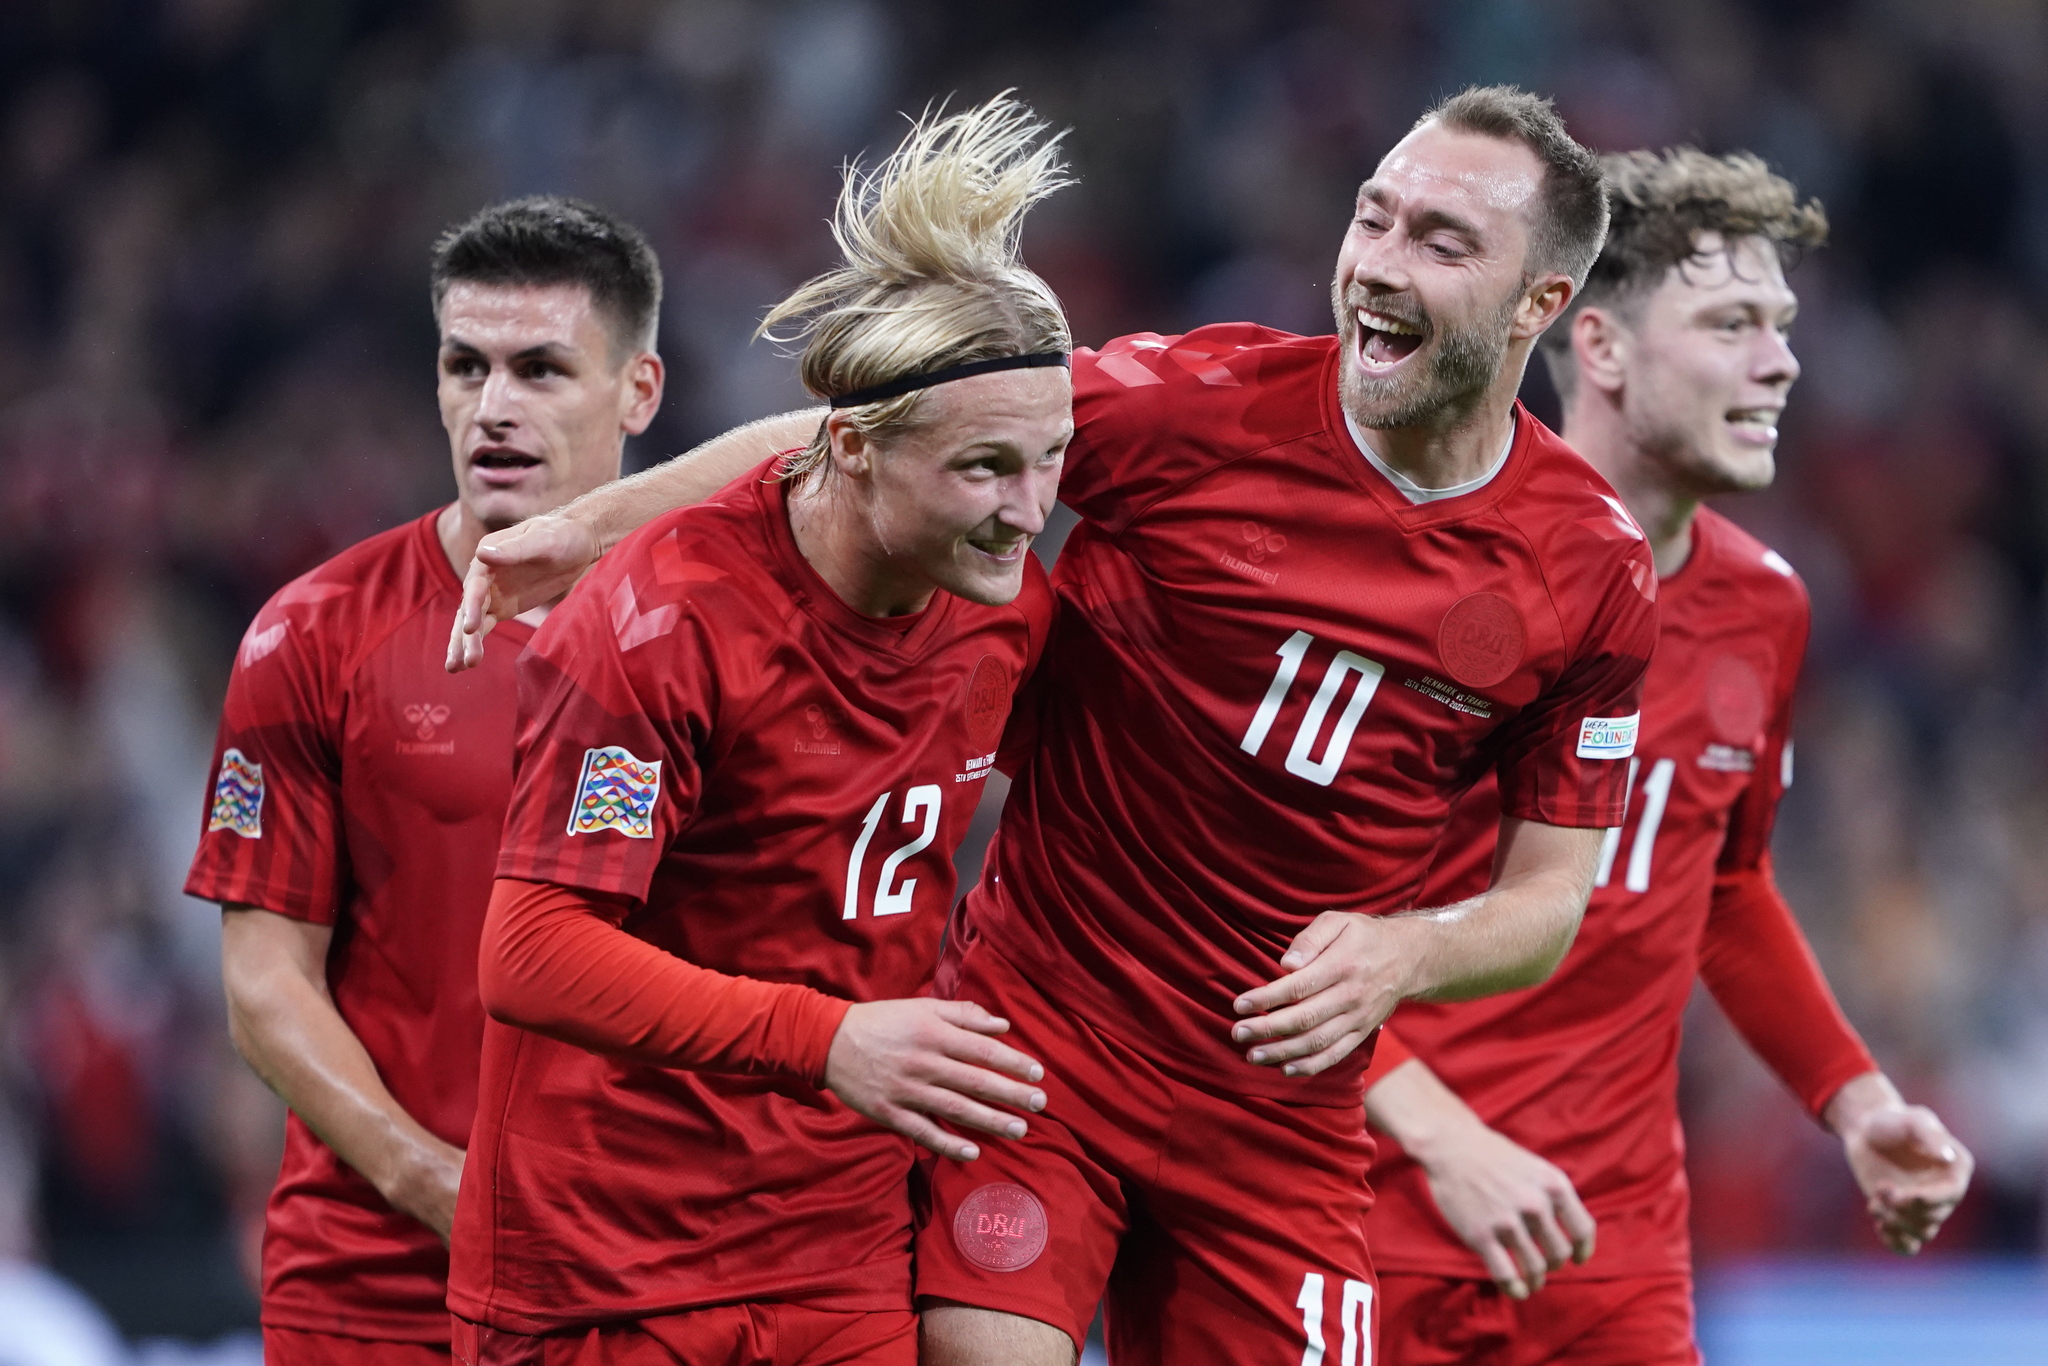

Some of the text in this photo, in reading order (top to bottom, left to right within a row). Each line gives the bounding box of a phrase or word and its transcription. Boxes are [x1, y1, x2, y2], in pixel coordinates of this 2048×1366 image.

[1220, 549, 1279, 585] hummel
[1240, 630, 1386, 786] 10
[1404, 678, 1420, 690] 25TH
[1418, 685, 1451, 705] SEPTEMBER
[1422, 676, 1458, 697] DENMARK
[1464, 694, 1492, 709] FRANCE
[1584, 721, 1608, 729] UEFA
[794, 738, 840, 755] hummel
[842, 784, 942, 920] 12
[976, 1213, 1027, 1239] DBU
[1296, 1271, 1374, 1366] 10
